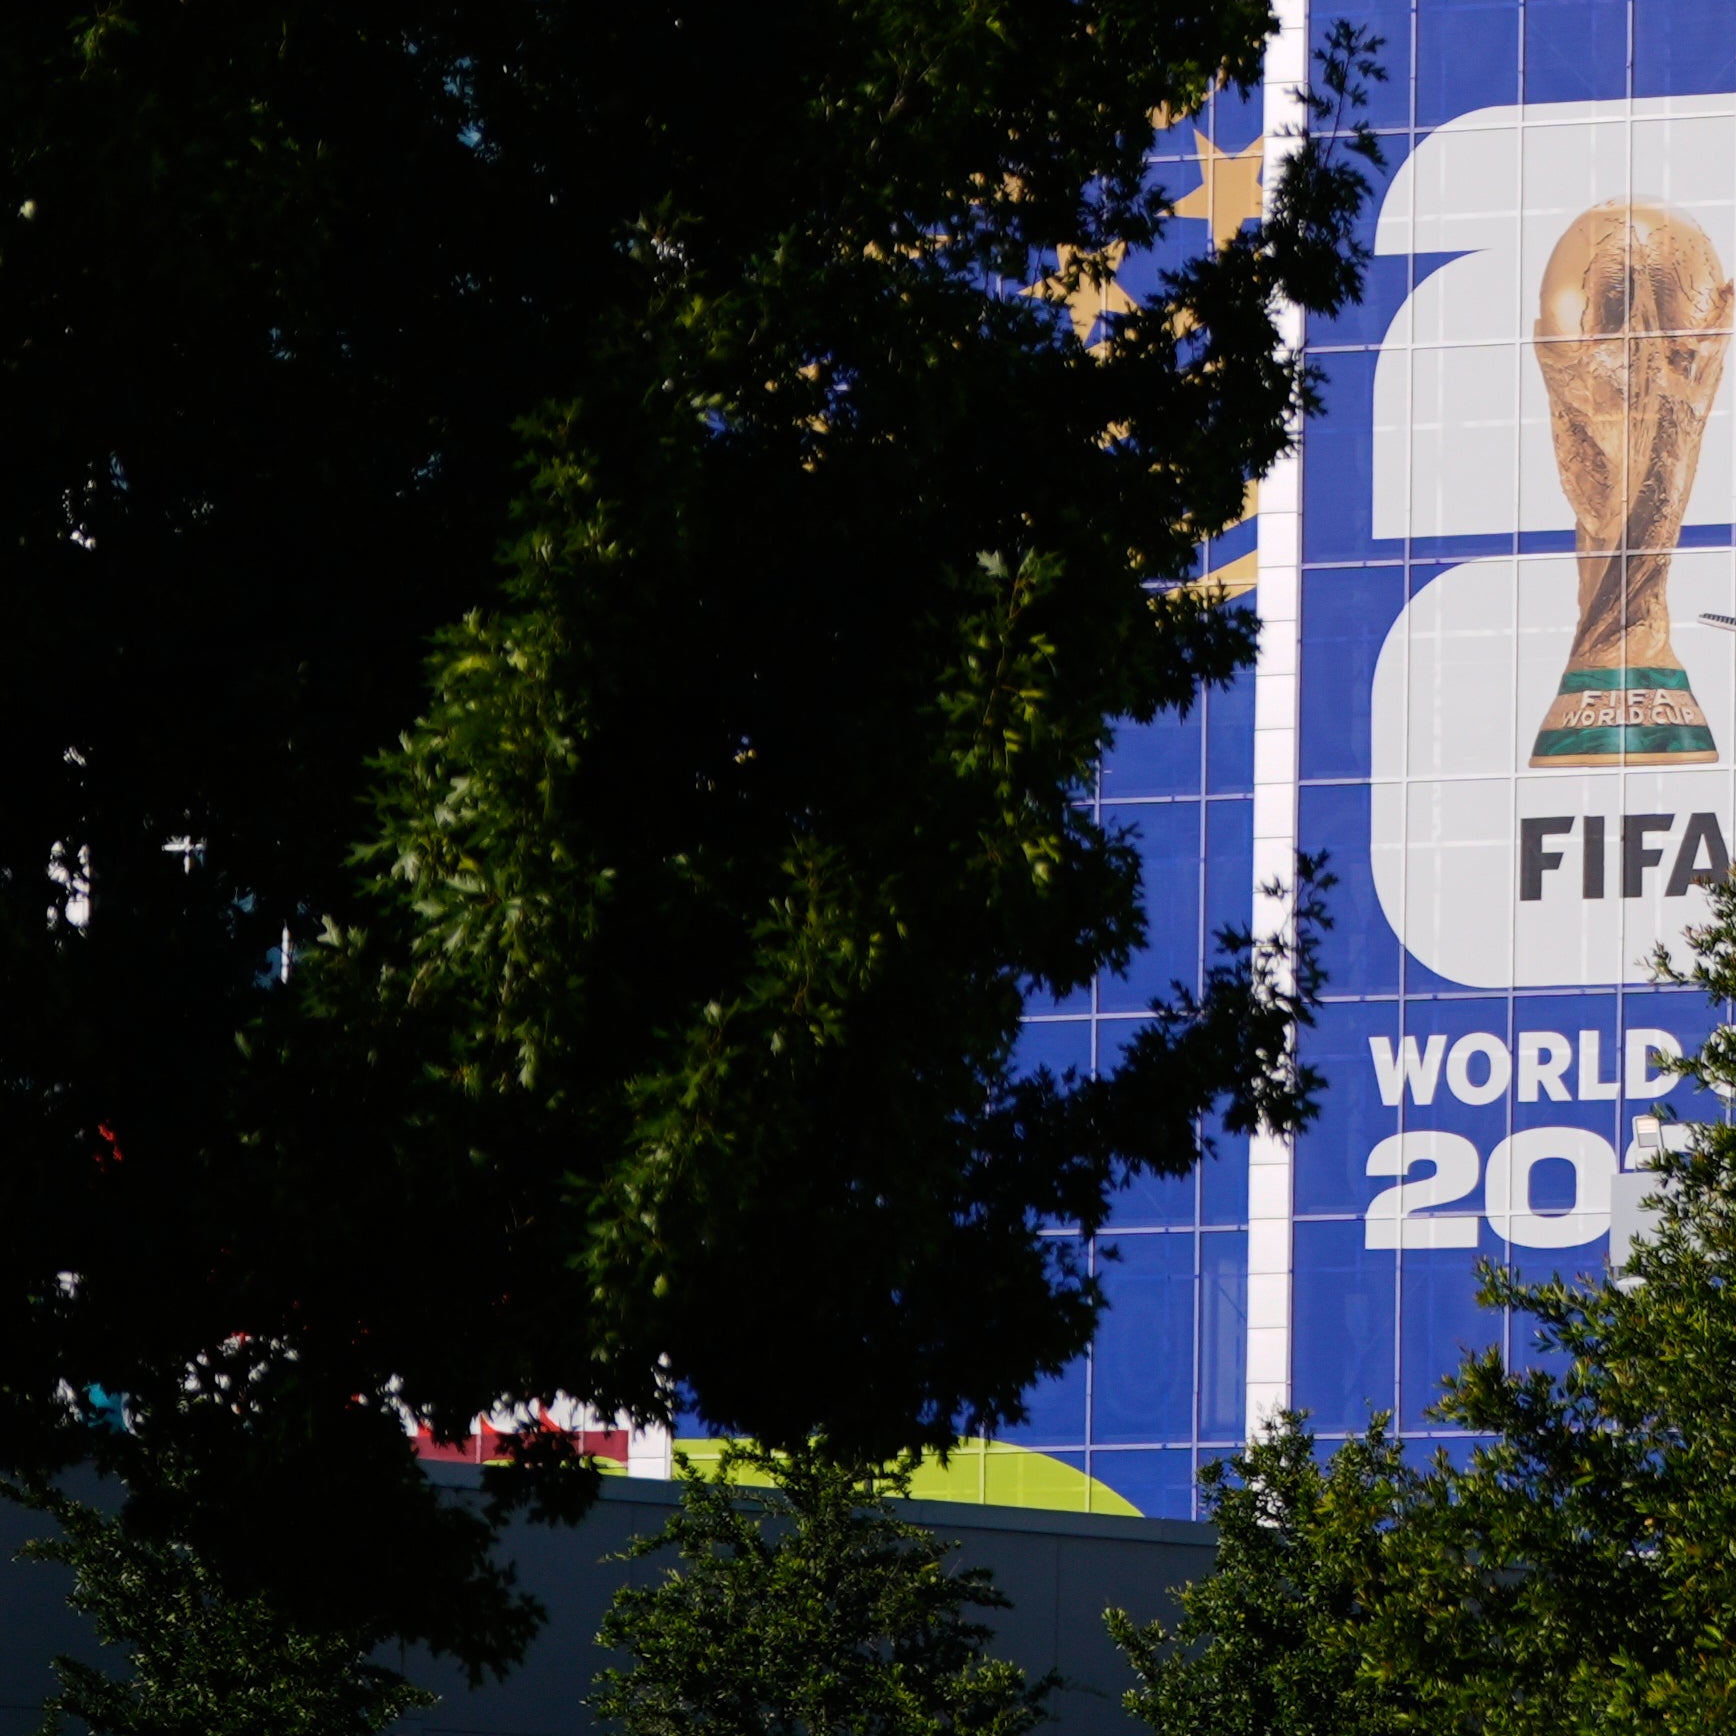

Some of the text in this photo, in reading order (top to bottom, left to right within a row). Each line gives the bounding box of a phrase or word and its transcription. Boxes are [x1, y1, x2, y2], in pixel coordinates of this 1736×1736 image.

[1561, 706, 1696, 728] WORLD CUP
[1580, 688, 1676, 709] FIFA
[1519, 811, 1731, 901] FIFA
[1368, 1027, 1684, 1106] WORLD
